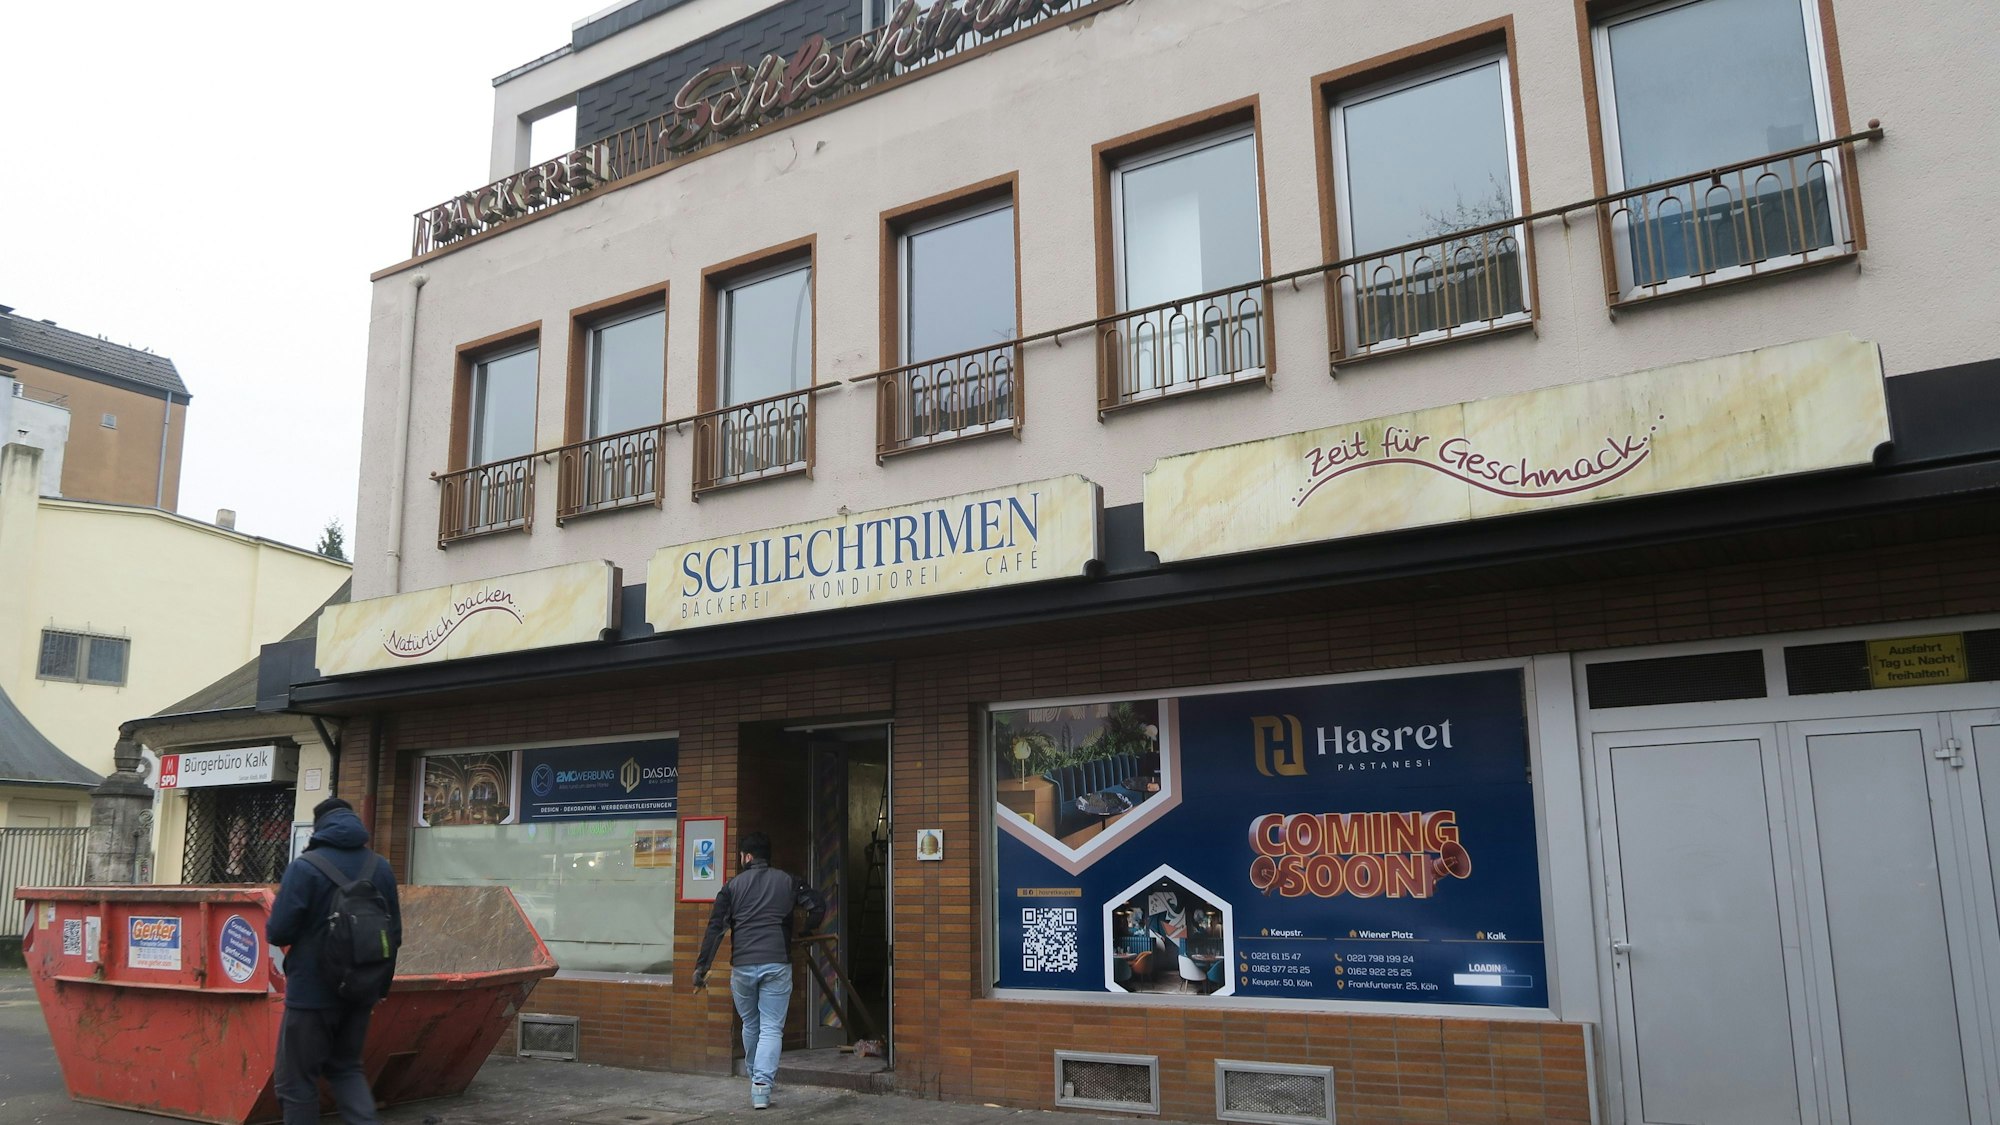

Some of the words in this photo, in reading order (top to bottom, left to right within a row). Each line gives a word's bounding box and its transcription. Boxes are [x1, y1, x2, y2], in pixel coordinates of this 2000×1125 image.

[1304, 431, 1369, 477] Zeit
[1381, 426, 1430, 458] für
[1438, 435, 1645, 488] Geschmack
[682, 492, 1040, 599] SCHLECHTRIMEN
[681, 591, 769, 619] BÄCKEREI
[808, 565, 938, 601] KONDITOREI
[984, 544, 1038, 576] CAFÉ
[388, 616, 453, 651] Natürlich
[454, 585, 514, 616] backen
[1888, 643, 1943, 656] Ausfahrt
[1879, 658, 1901, 669] Tag
[1903, 658, 1915, 667] u.
[1917, 654, 1956, 665] Nacht
[1887, 668, 1950, 681] freihalten!
[1316, 718, 1453, 756] Hasret
[184, 753, 242, 775] Bürgerbüro
[245, 751, 268, 768] Kalk
[556, 769, 615, 783] 2MCWERBUNG
[643, 766, 678, 780] DASDA
[161, 774, 177, 787] SPD
[601, 802, 672, 811] WERBEDIENSTLEISTUNGEN
[1248, 810, 1459, 857] COMING
[1278, 853, 1428, 899] SOON
[1270, 928, 1304, 938] Keupstr.
[1358, 930, 1390, 939] Wiener
[1391, 930, 1414, 939] Platz
[1486, 931, 1507, 940] Kalk
[1251, 952, 1270, 960] 0221
[1271, 952, 1281, 960] 61
[1281, 952, 1291, 960] 15
[1346, 954, 1367, 962] 0221
[1368, 954, 1385, 962] 798
[1386, 955, 1401, 963] 199
[1402, 955, 1414, 963] 24
[1251, 965, 1271, 973] 0162
[1271, 965, 1286, 973] 977
[1299, 966, 1311, 974] 25
[1347, 967, 1367, 975] 0162
[1368, 968, 1386, 976] 922
[1387, 968, 1399, 976] 25
[1400, 968, 1412, 977] 25
[1251, 978, 1281, 987] Keupstr.
[1282, 979, 1295, 987] 50,
[1296, 978, 1313, 987] Köln
[1348, 980, 1403, 990] Frankfurterstr.
[1405, 982, 1419, 990] 25,
[1420, 981, 1438, 990] Köln
